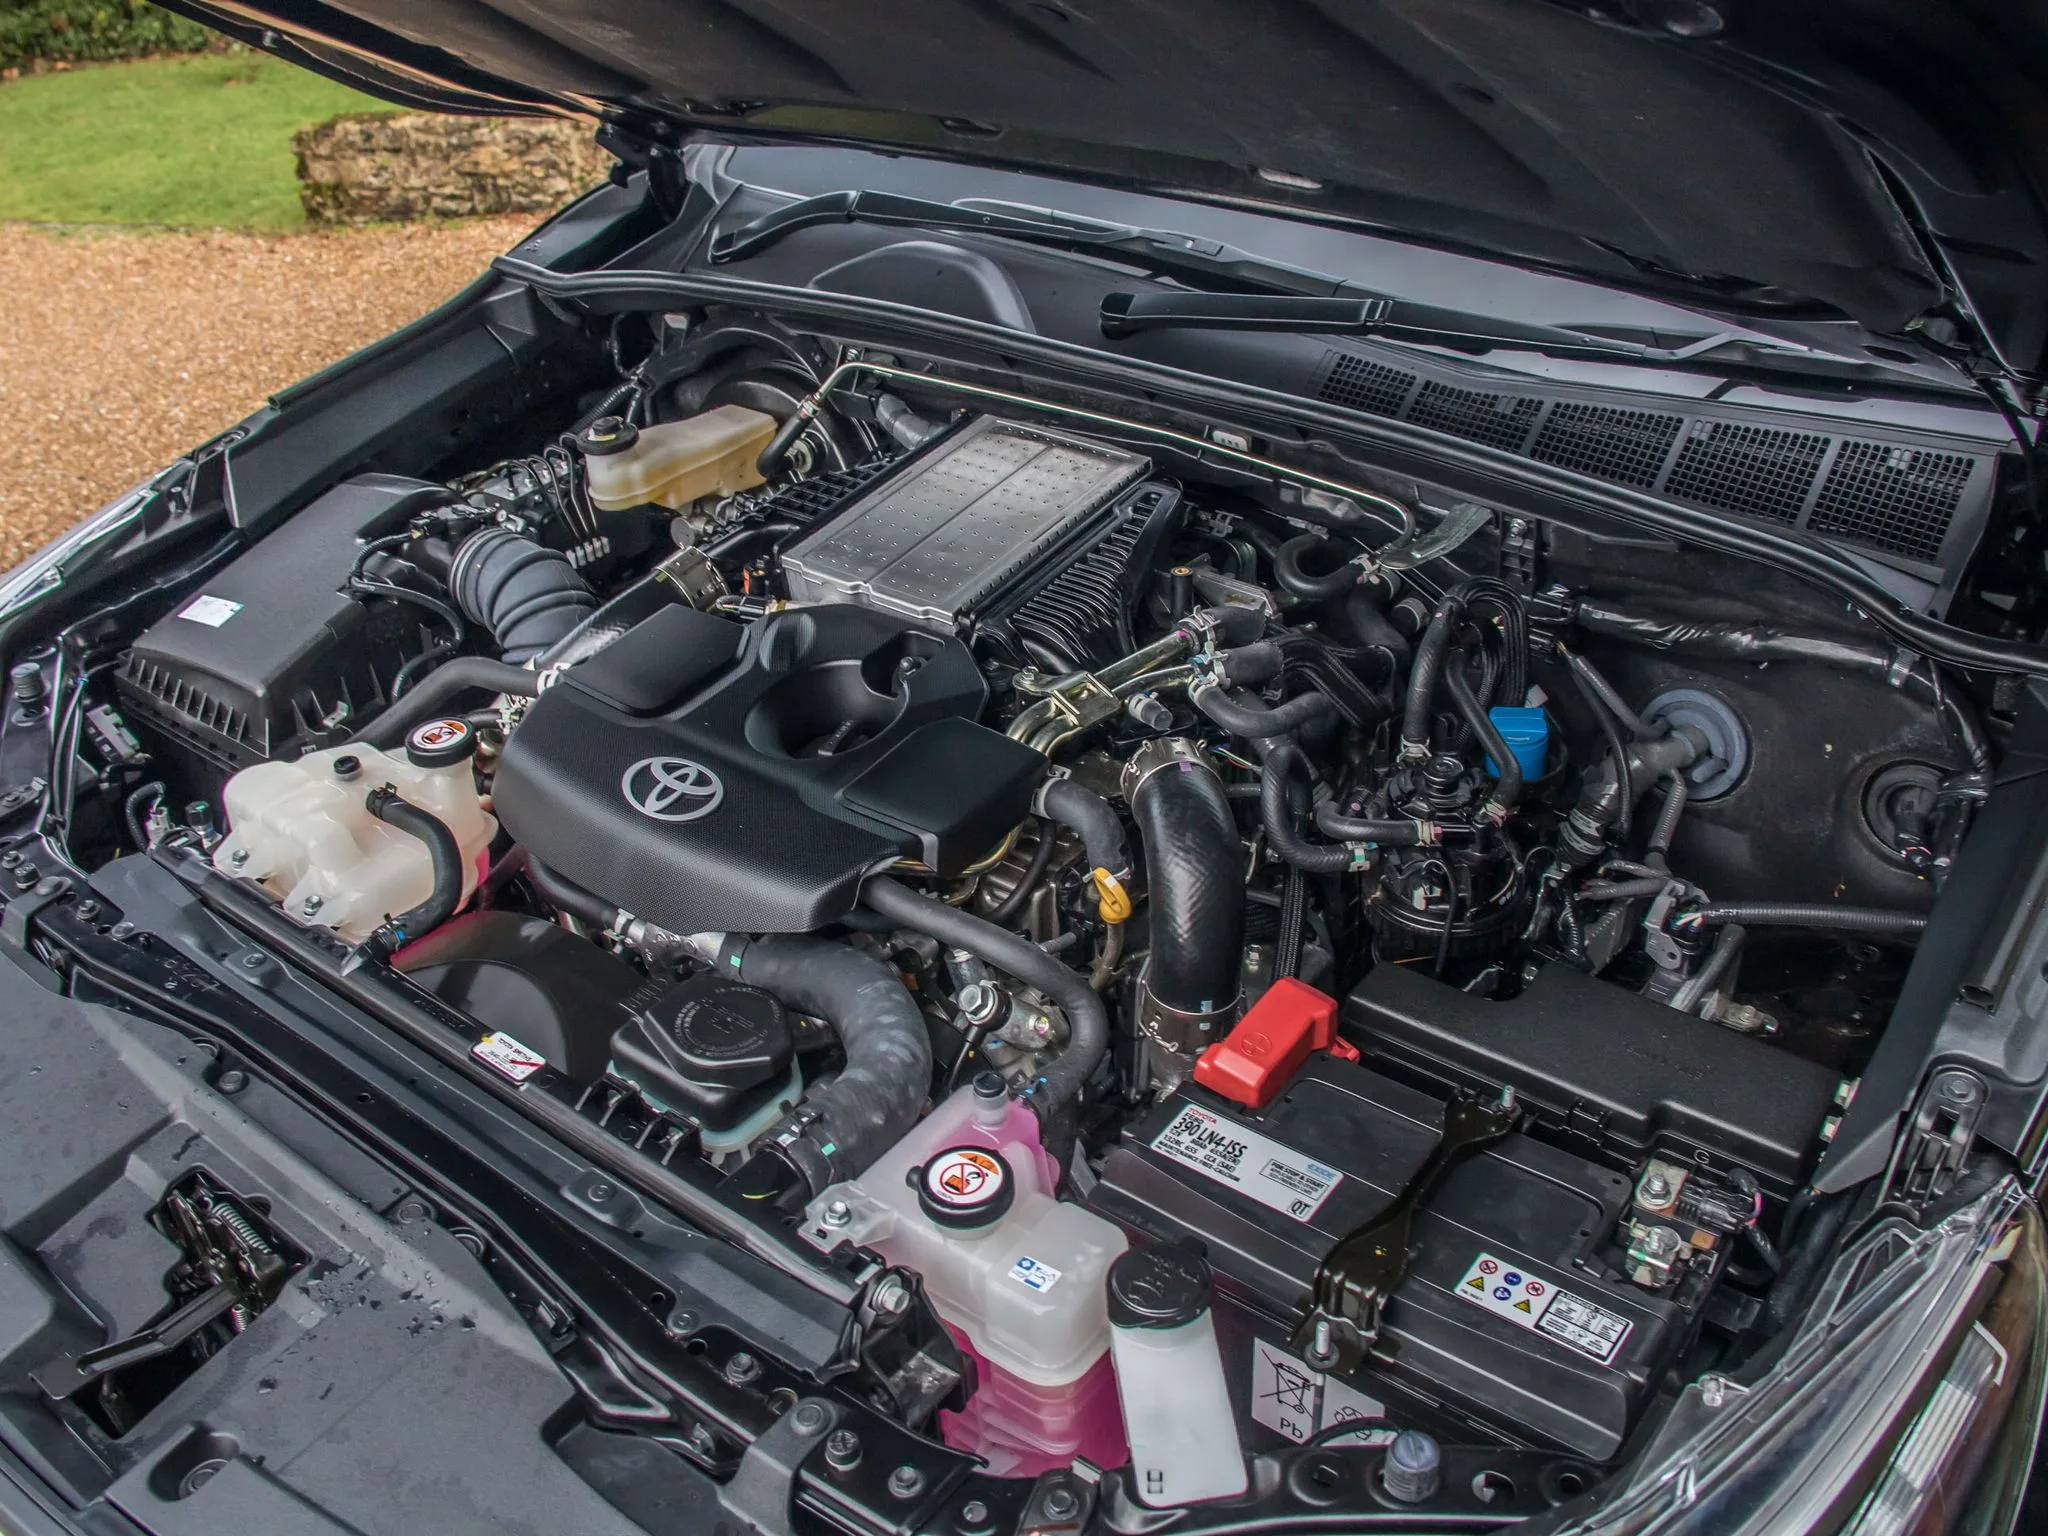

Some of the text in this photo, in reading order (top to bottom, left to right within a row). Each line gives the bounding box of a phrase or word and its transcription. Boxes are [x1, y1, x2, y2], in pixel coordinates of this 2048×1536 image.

[1189, 1107, 1217, 1124] TOYOTA
[1169, 1128, 1183, 1137] 12V
[1174, 1117, 1200, 1136] 390
[1197, 1128, 1248, 1157] LN4-ISS
[1158, 1140, 1198, 1163] MAINTENANCE
[1185, 1145, 1198, 1154] 655
[1203, 1154, 1217, 1163] CCA
[1693, 1149, 1710, 1164] G
[1271, 1162, 1284, 1170] FOR
[1284, 1168, 1300, 1177] STOP
[1305, 1177, 1324, 1189] START
[1291, 1200, 1312, 1216] QT
[1280, 1417, 1303, 1438] Pb
